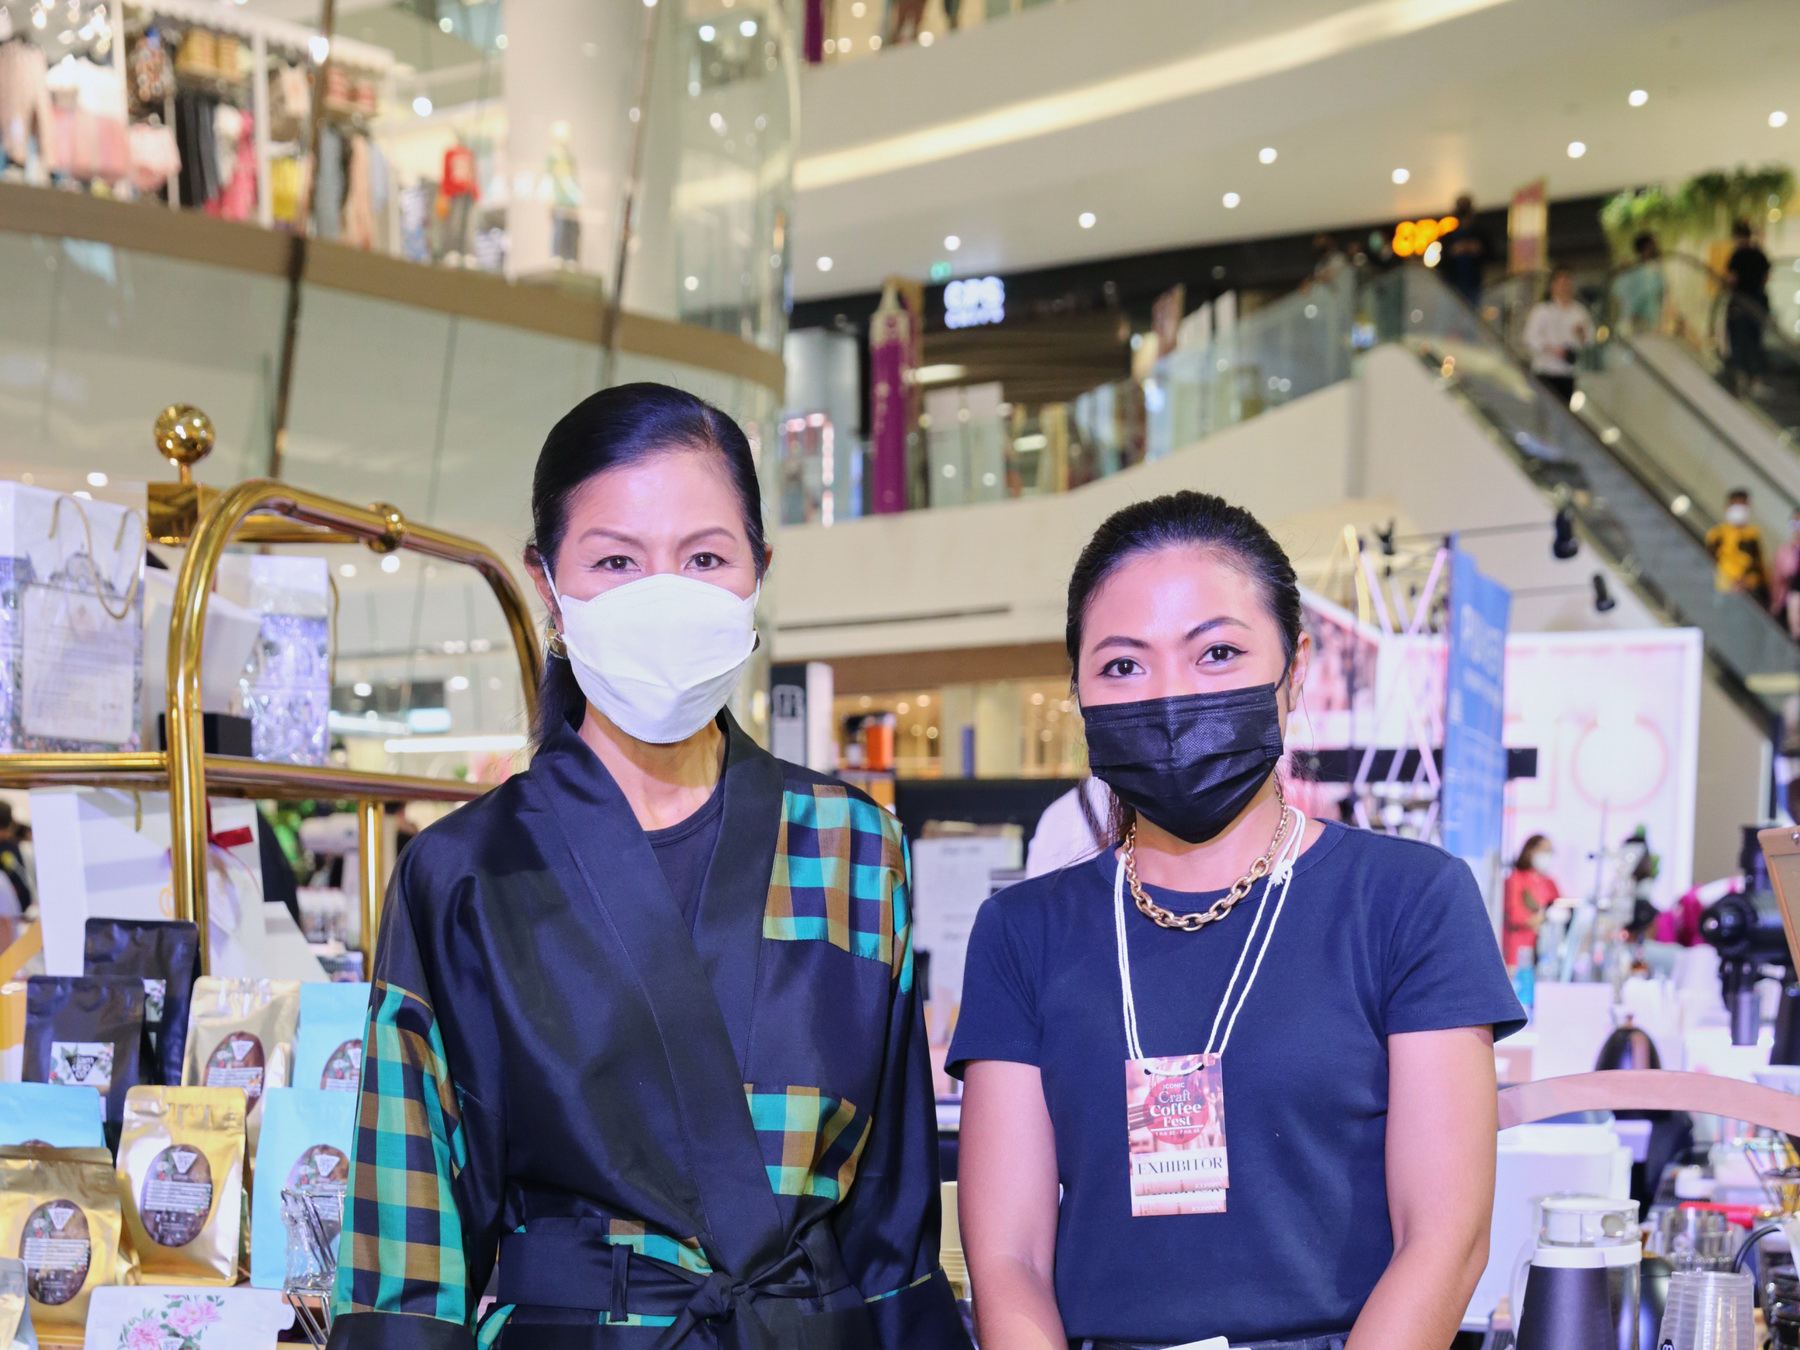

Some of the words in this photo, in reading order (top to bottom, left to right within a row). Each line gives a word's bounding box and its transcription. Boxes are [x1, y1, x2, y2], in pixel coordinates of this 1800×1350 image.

[1158, 1089, 1191, 1103] Craft
[1150, 1102, 1202, 1117] Coffee
[1163, 1116, 1192, 1128] Fest
[1138, 1156, 1223, 1175] EXHIBITOR
